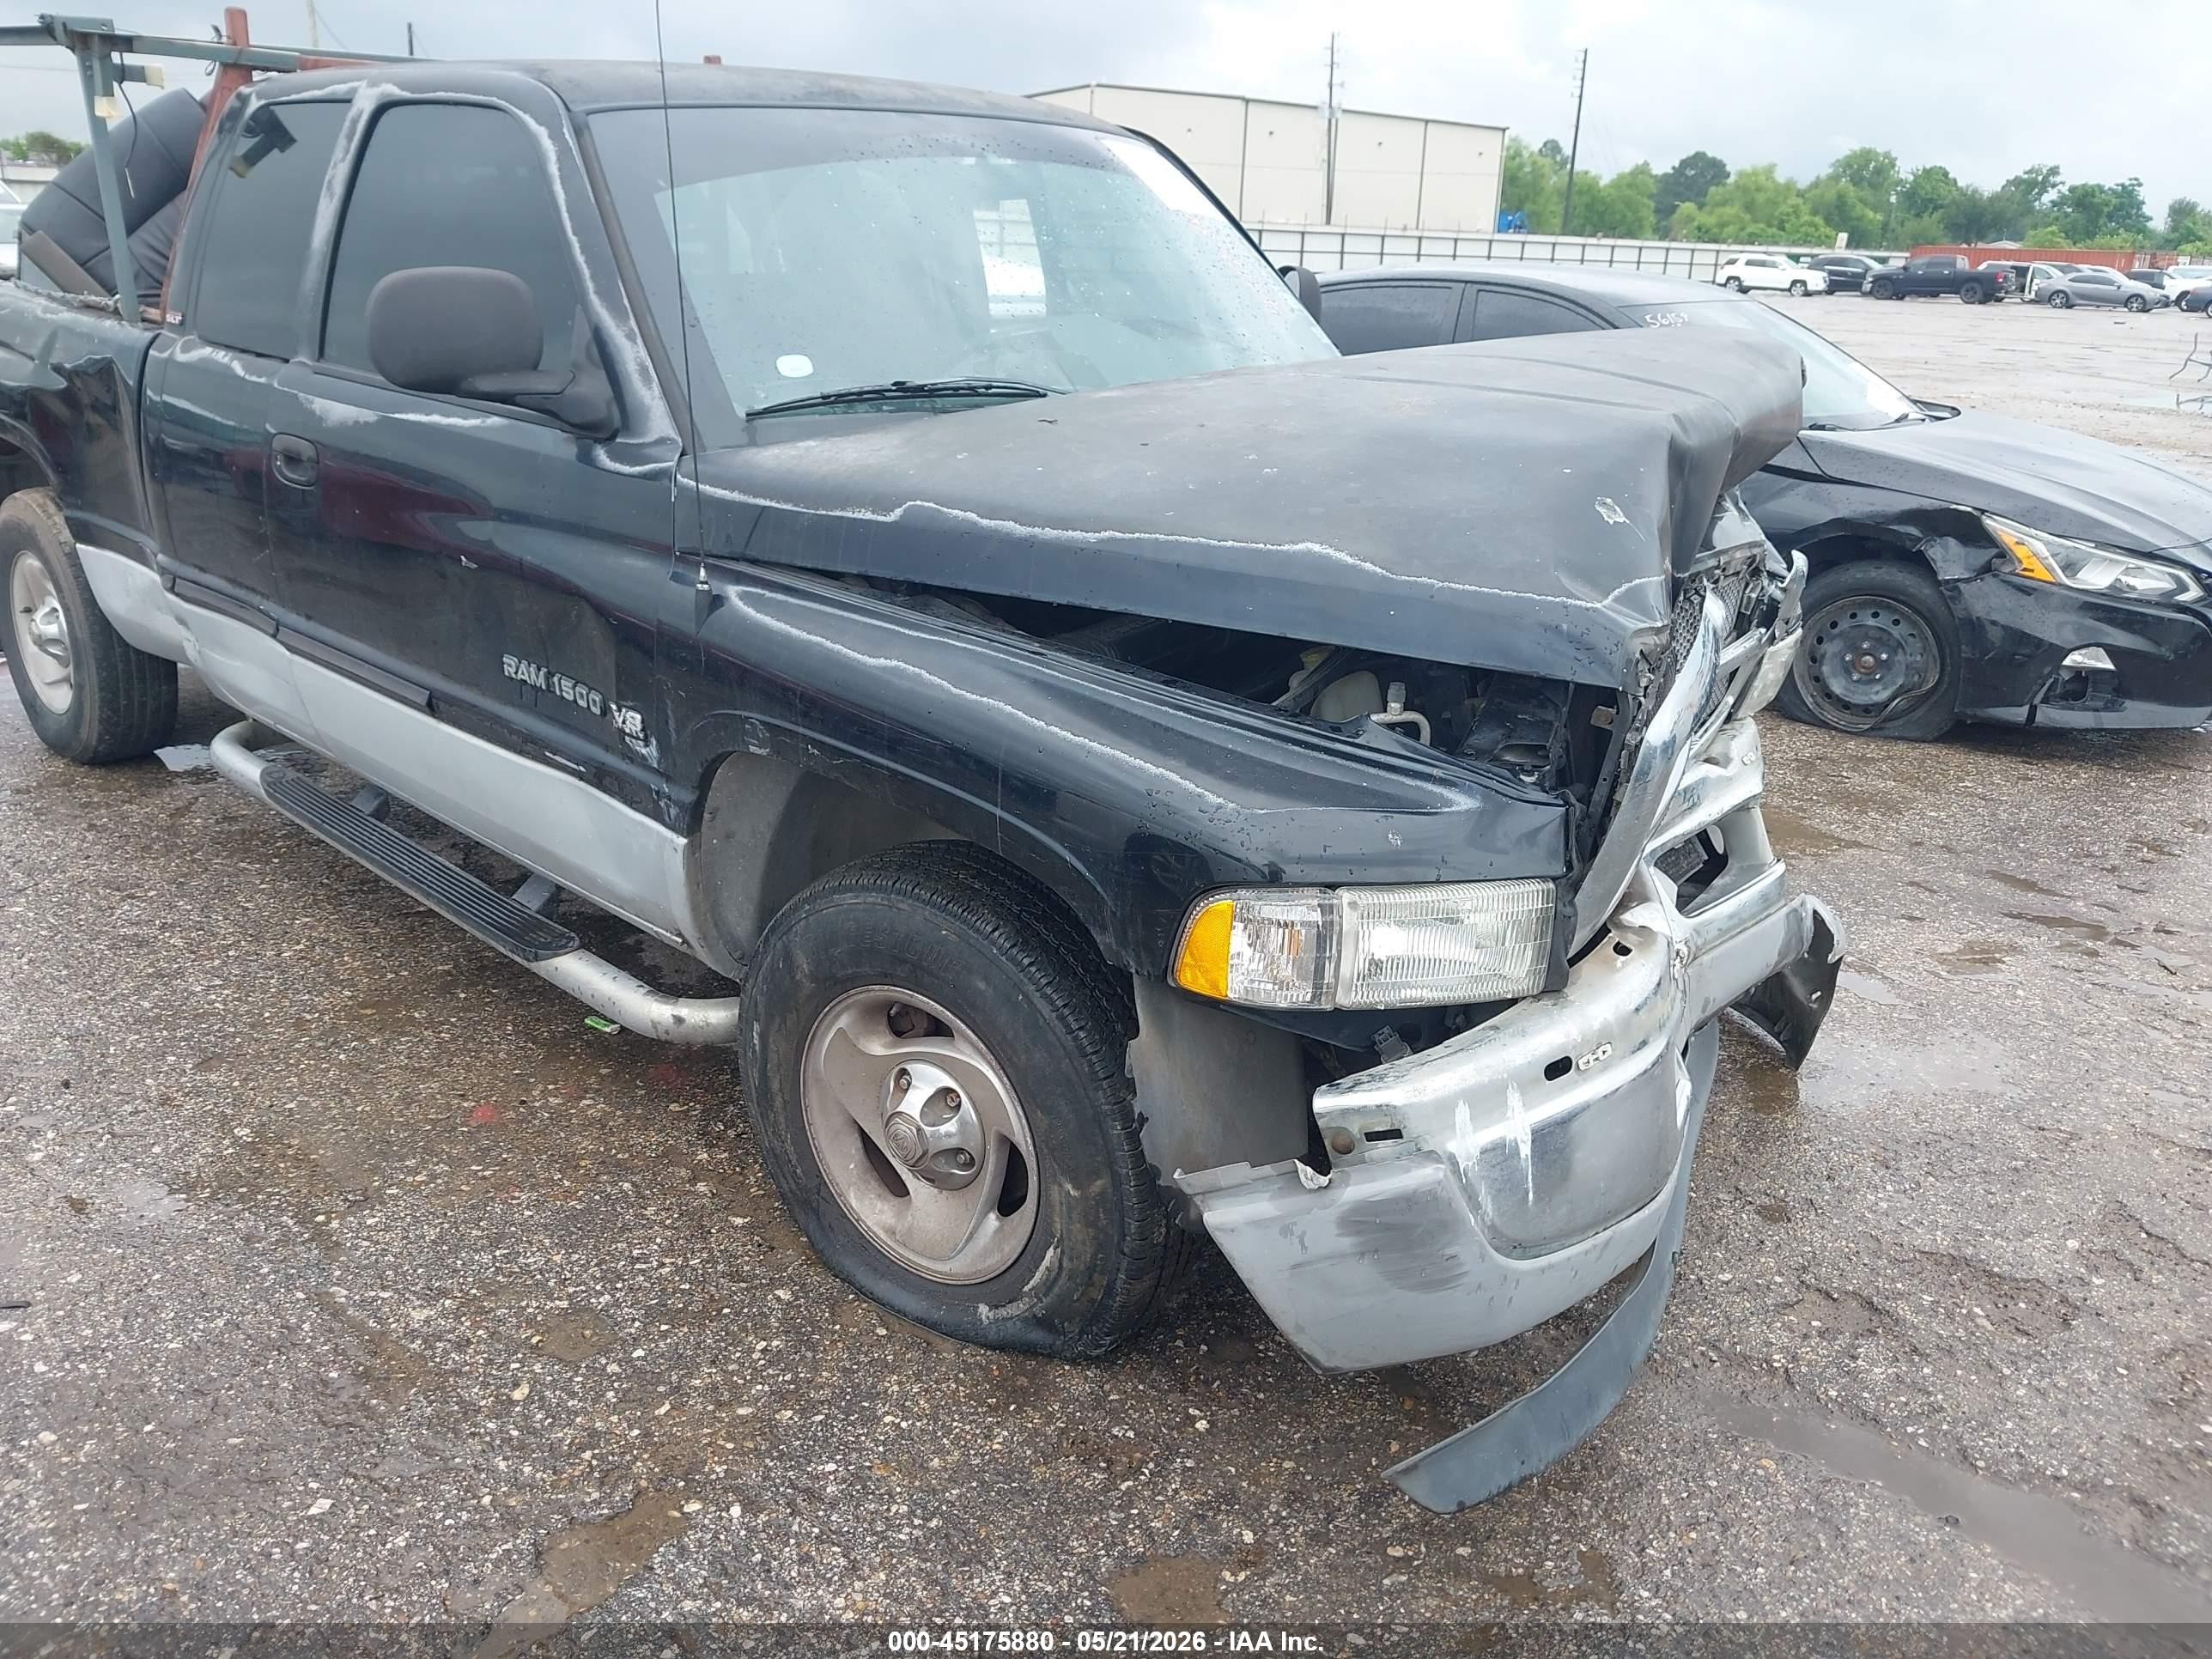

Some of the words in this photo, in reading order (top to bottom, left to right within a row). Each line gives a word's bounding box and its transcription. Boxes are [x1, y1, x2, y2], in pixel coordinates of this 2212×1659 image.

[502, 653, 548, 690] RAM
[552, 672, 604, 716] 1500
[608, 701, 643, 739] V8
